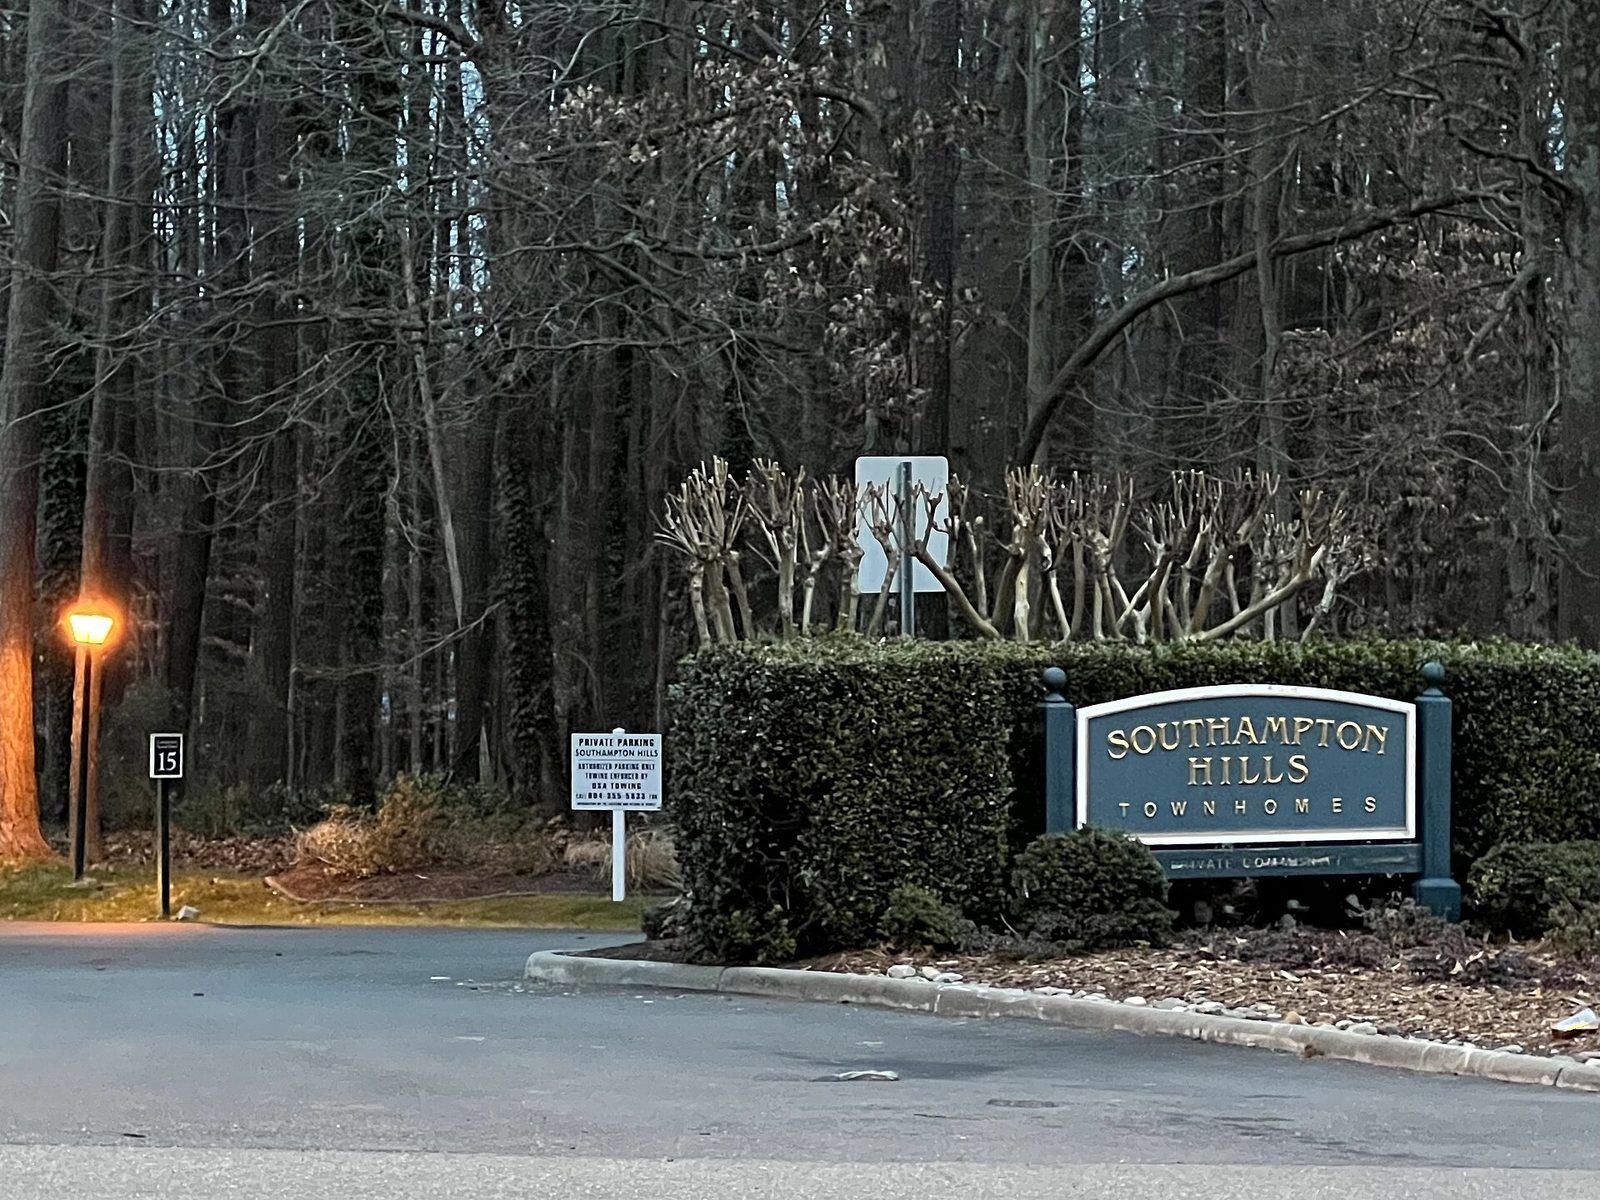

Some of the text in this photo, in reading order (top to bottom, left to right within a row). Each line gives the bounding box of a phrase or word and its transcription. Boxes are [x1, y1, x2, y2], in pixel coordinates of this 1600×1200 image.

[579, 738, 654, 747] PRIVATE PARKING
[1107, 716, 1389, 760] SOUTHAMPTON
[158, 751, 177, 771] 15
[575, 749, 658, 757] SOUTHAMPTON HILLS
[1187, 754, 1310, 786] HILLS
[1118, 796, 1377, 818] TOWNHOMES
[1170, 858, 1233, 870] IVATE
